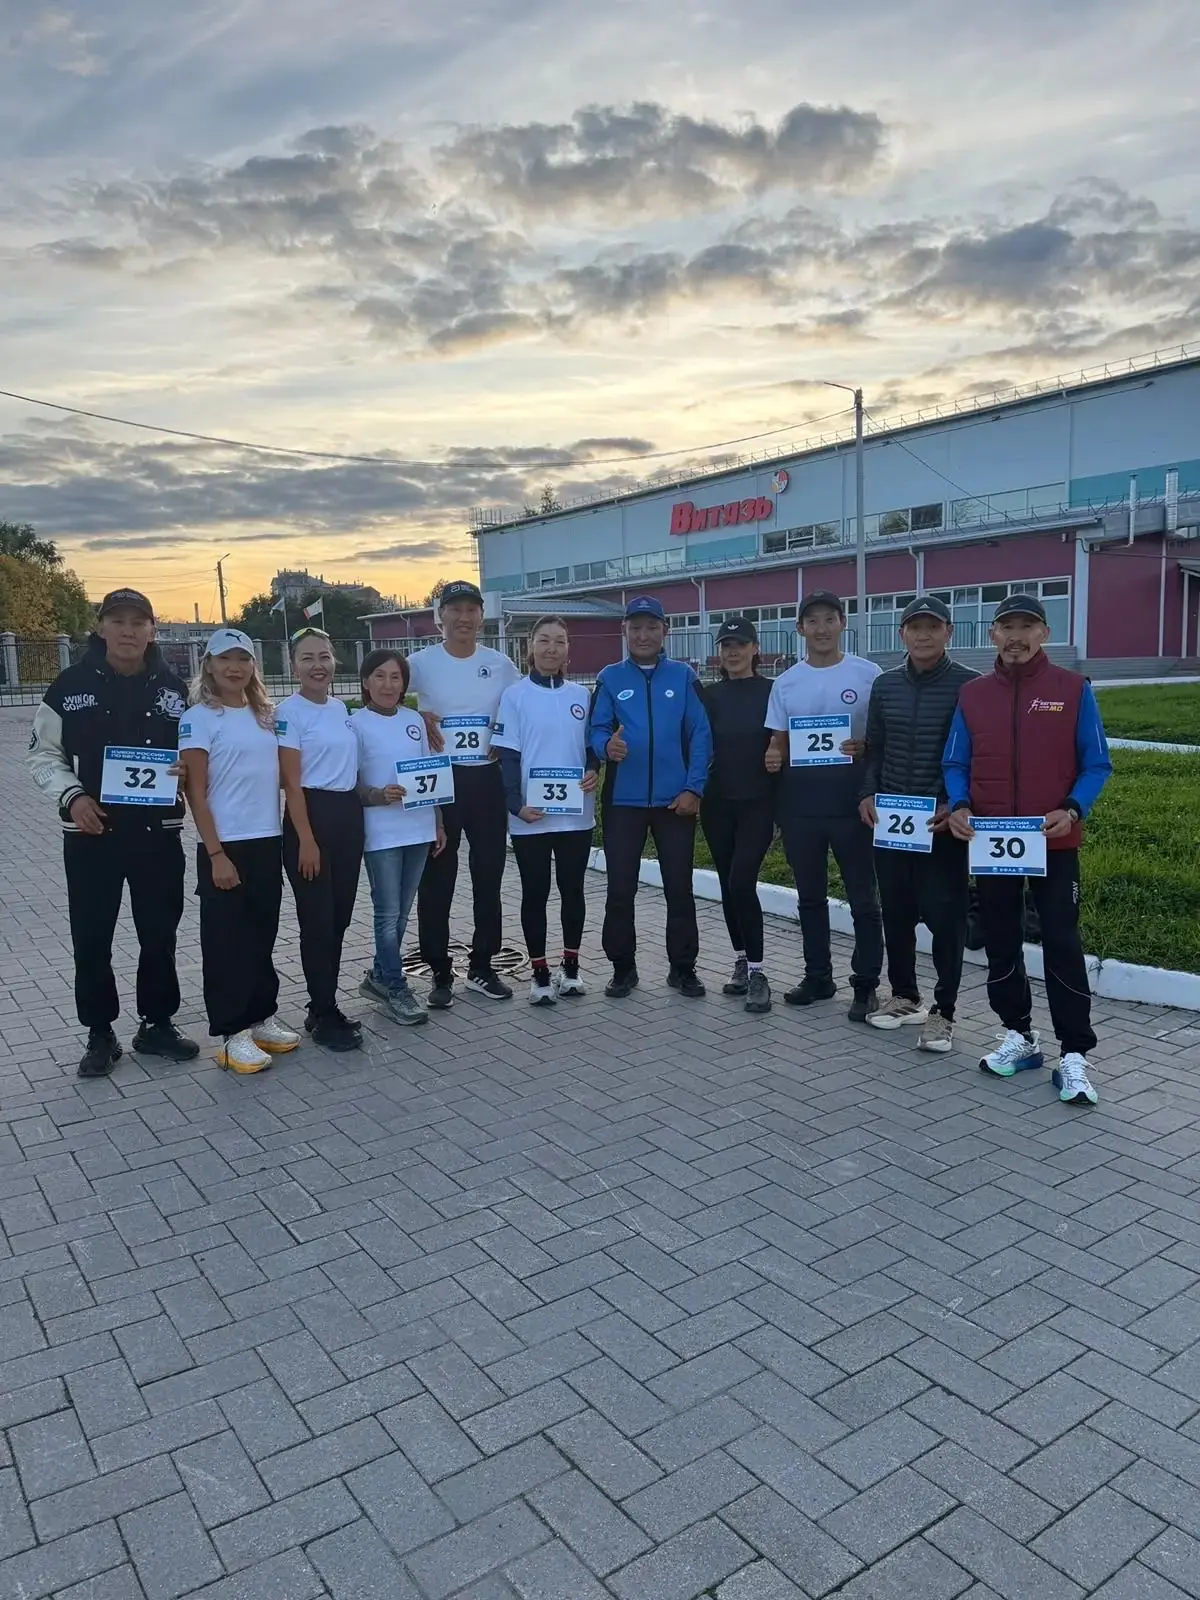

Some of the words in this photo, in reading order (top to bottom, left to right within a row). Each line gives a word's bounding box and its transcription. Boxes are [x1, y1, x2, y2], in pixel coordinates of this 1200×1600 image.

[670, 496, 773, 536] Витязь
[454, 731, 480, 749] 28
[807, 733, 834, 752] 25
[124, 766, 156, 789] 32
[414, 774, 438, 794] 37
[543, 783, 568, 801] 33
[887, 814, 915, 835] 26
[989, 837, 1026, 859] 30
